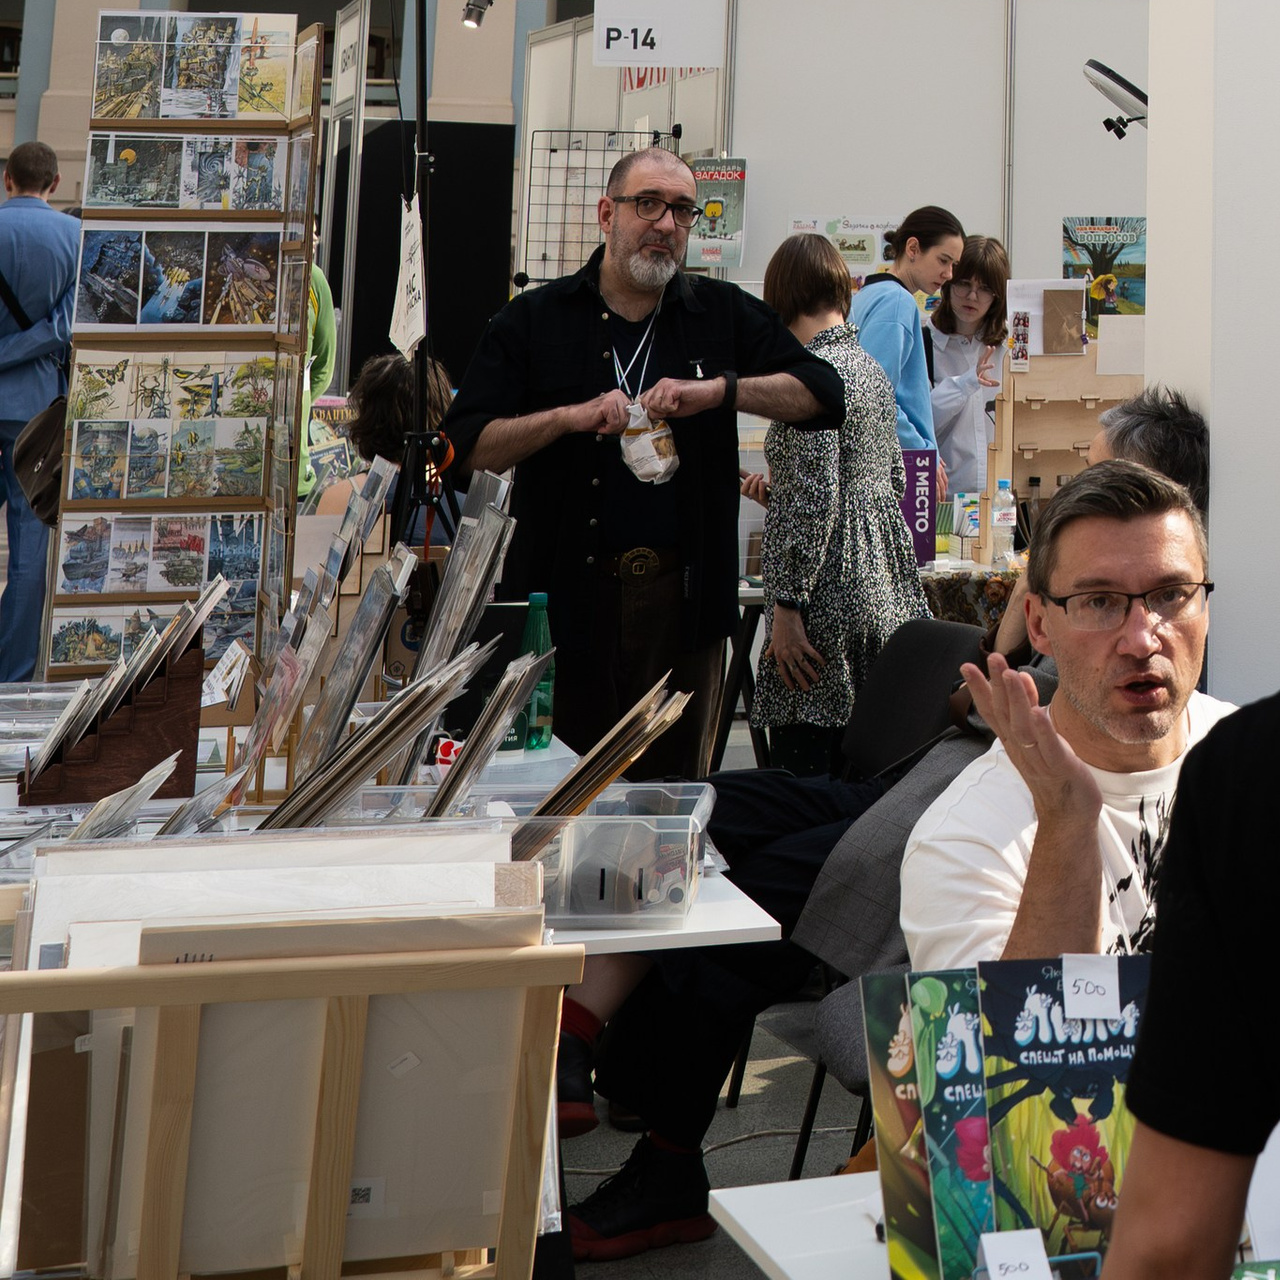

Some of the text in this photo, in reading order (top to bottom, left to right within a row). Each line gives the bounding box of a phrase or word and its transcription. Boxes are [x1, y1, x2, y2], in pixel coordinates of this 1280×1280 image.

[695, 171, 741, 181] ЗАГАДОК
[1079, 233, 1137, 244] ВОПРОСОВ
[915, 456, 930, 533] 3 МЕСТО
[1072, 978, 1107, 996] 500
[1019, 1044, 1135, 1065] СПЕШИТ НА ПОМОЩ
[997, 1262, 1030, 1275] 500
